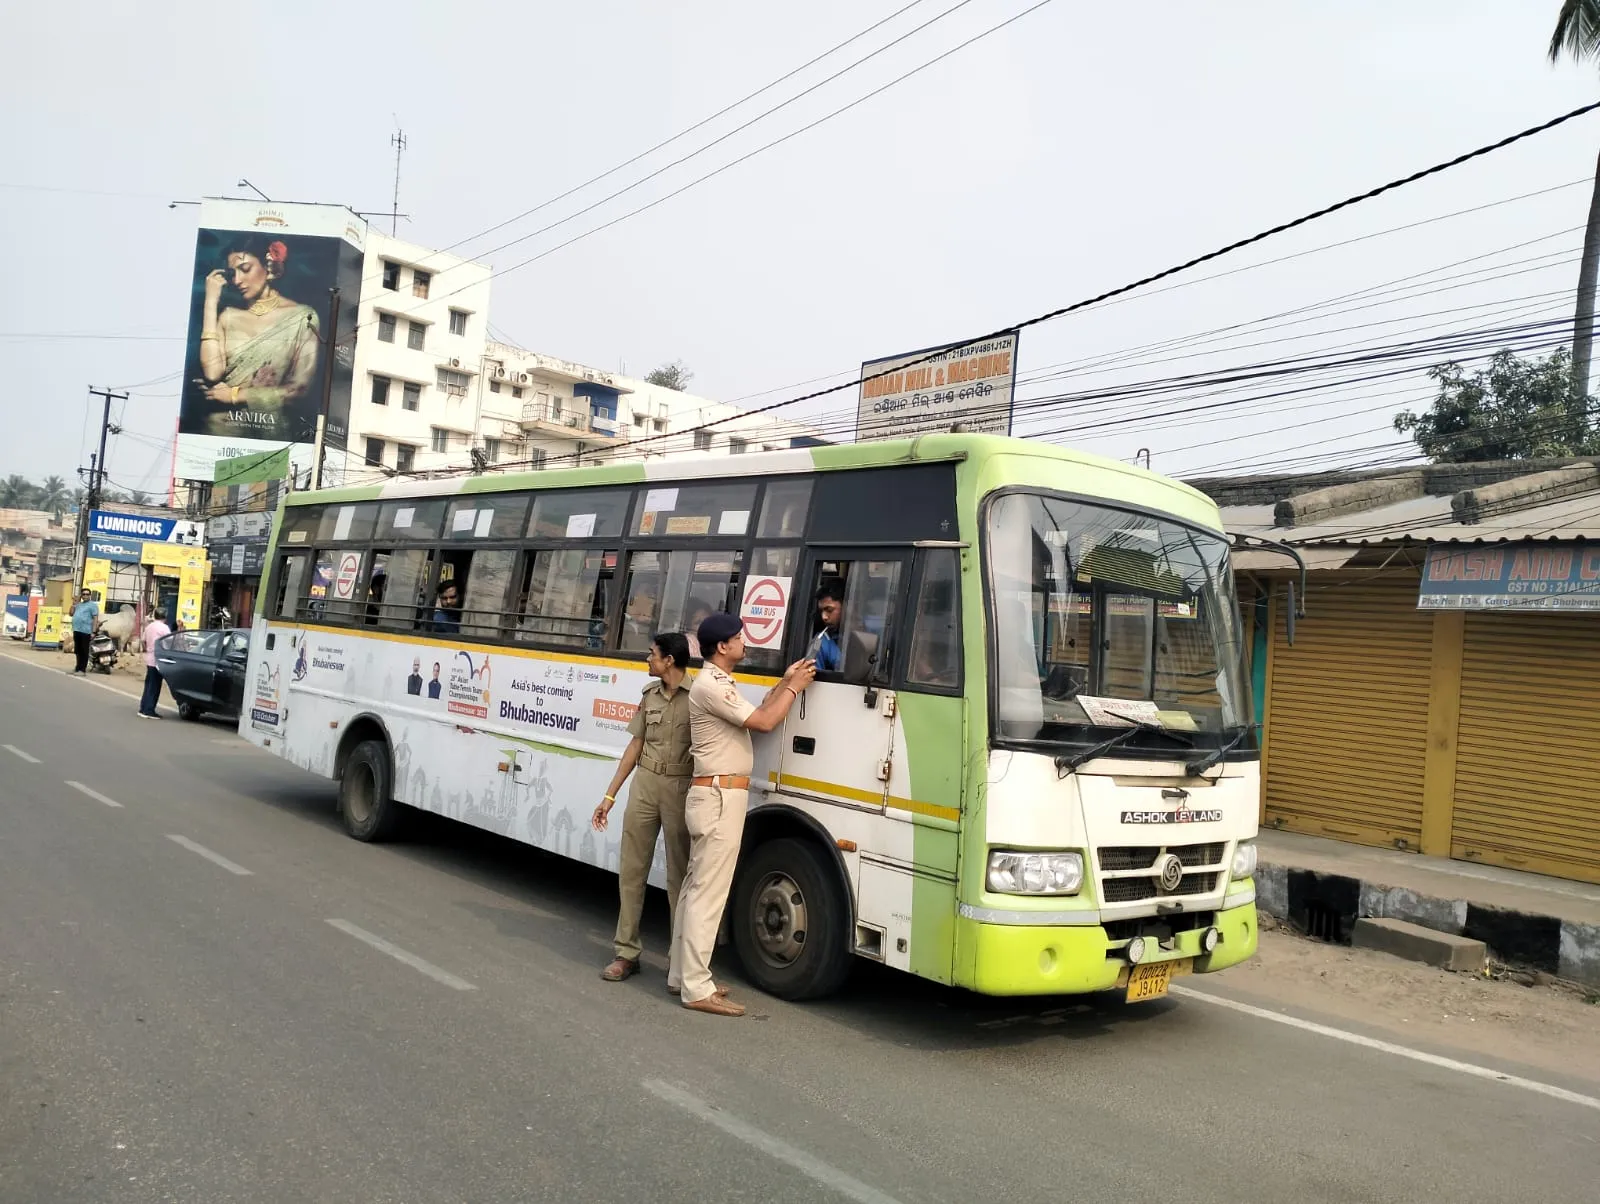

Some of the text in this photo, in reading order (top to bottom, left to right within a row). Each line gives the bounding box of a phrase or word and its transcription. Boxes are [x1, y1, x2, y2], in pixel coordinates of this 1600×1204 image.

[904, 367, 933, 392] MILL
[935, 367, 945, 386] &
[947, 351, 1011, 385] MACHINE
[225, 409, 276, 425] ARNIKA
[96, 515, 163, 536] LUMINOUS
[1428, 550, 1504, 582] DASH
[1580, 550, 1600, 581] C
[1507, 582, 1530, 593] GST
[1531, 582, 1548, 593] NO
[1556, 582, 1600, 594] 21ALMP
[751, 607, 777, 617] AMA BUS
[511, 679, 574, 701] Asia's best coming
[536, 696, 544, 706] to
[599, 702, 617, 716] 11-15
[500, 700, 581, 732] Bhubaneswar
[1124, 810, 1222, 823] ASHOK LEYLAND
